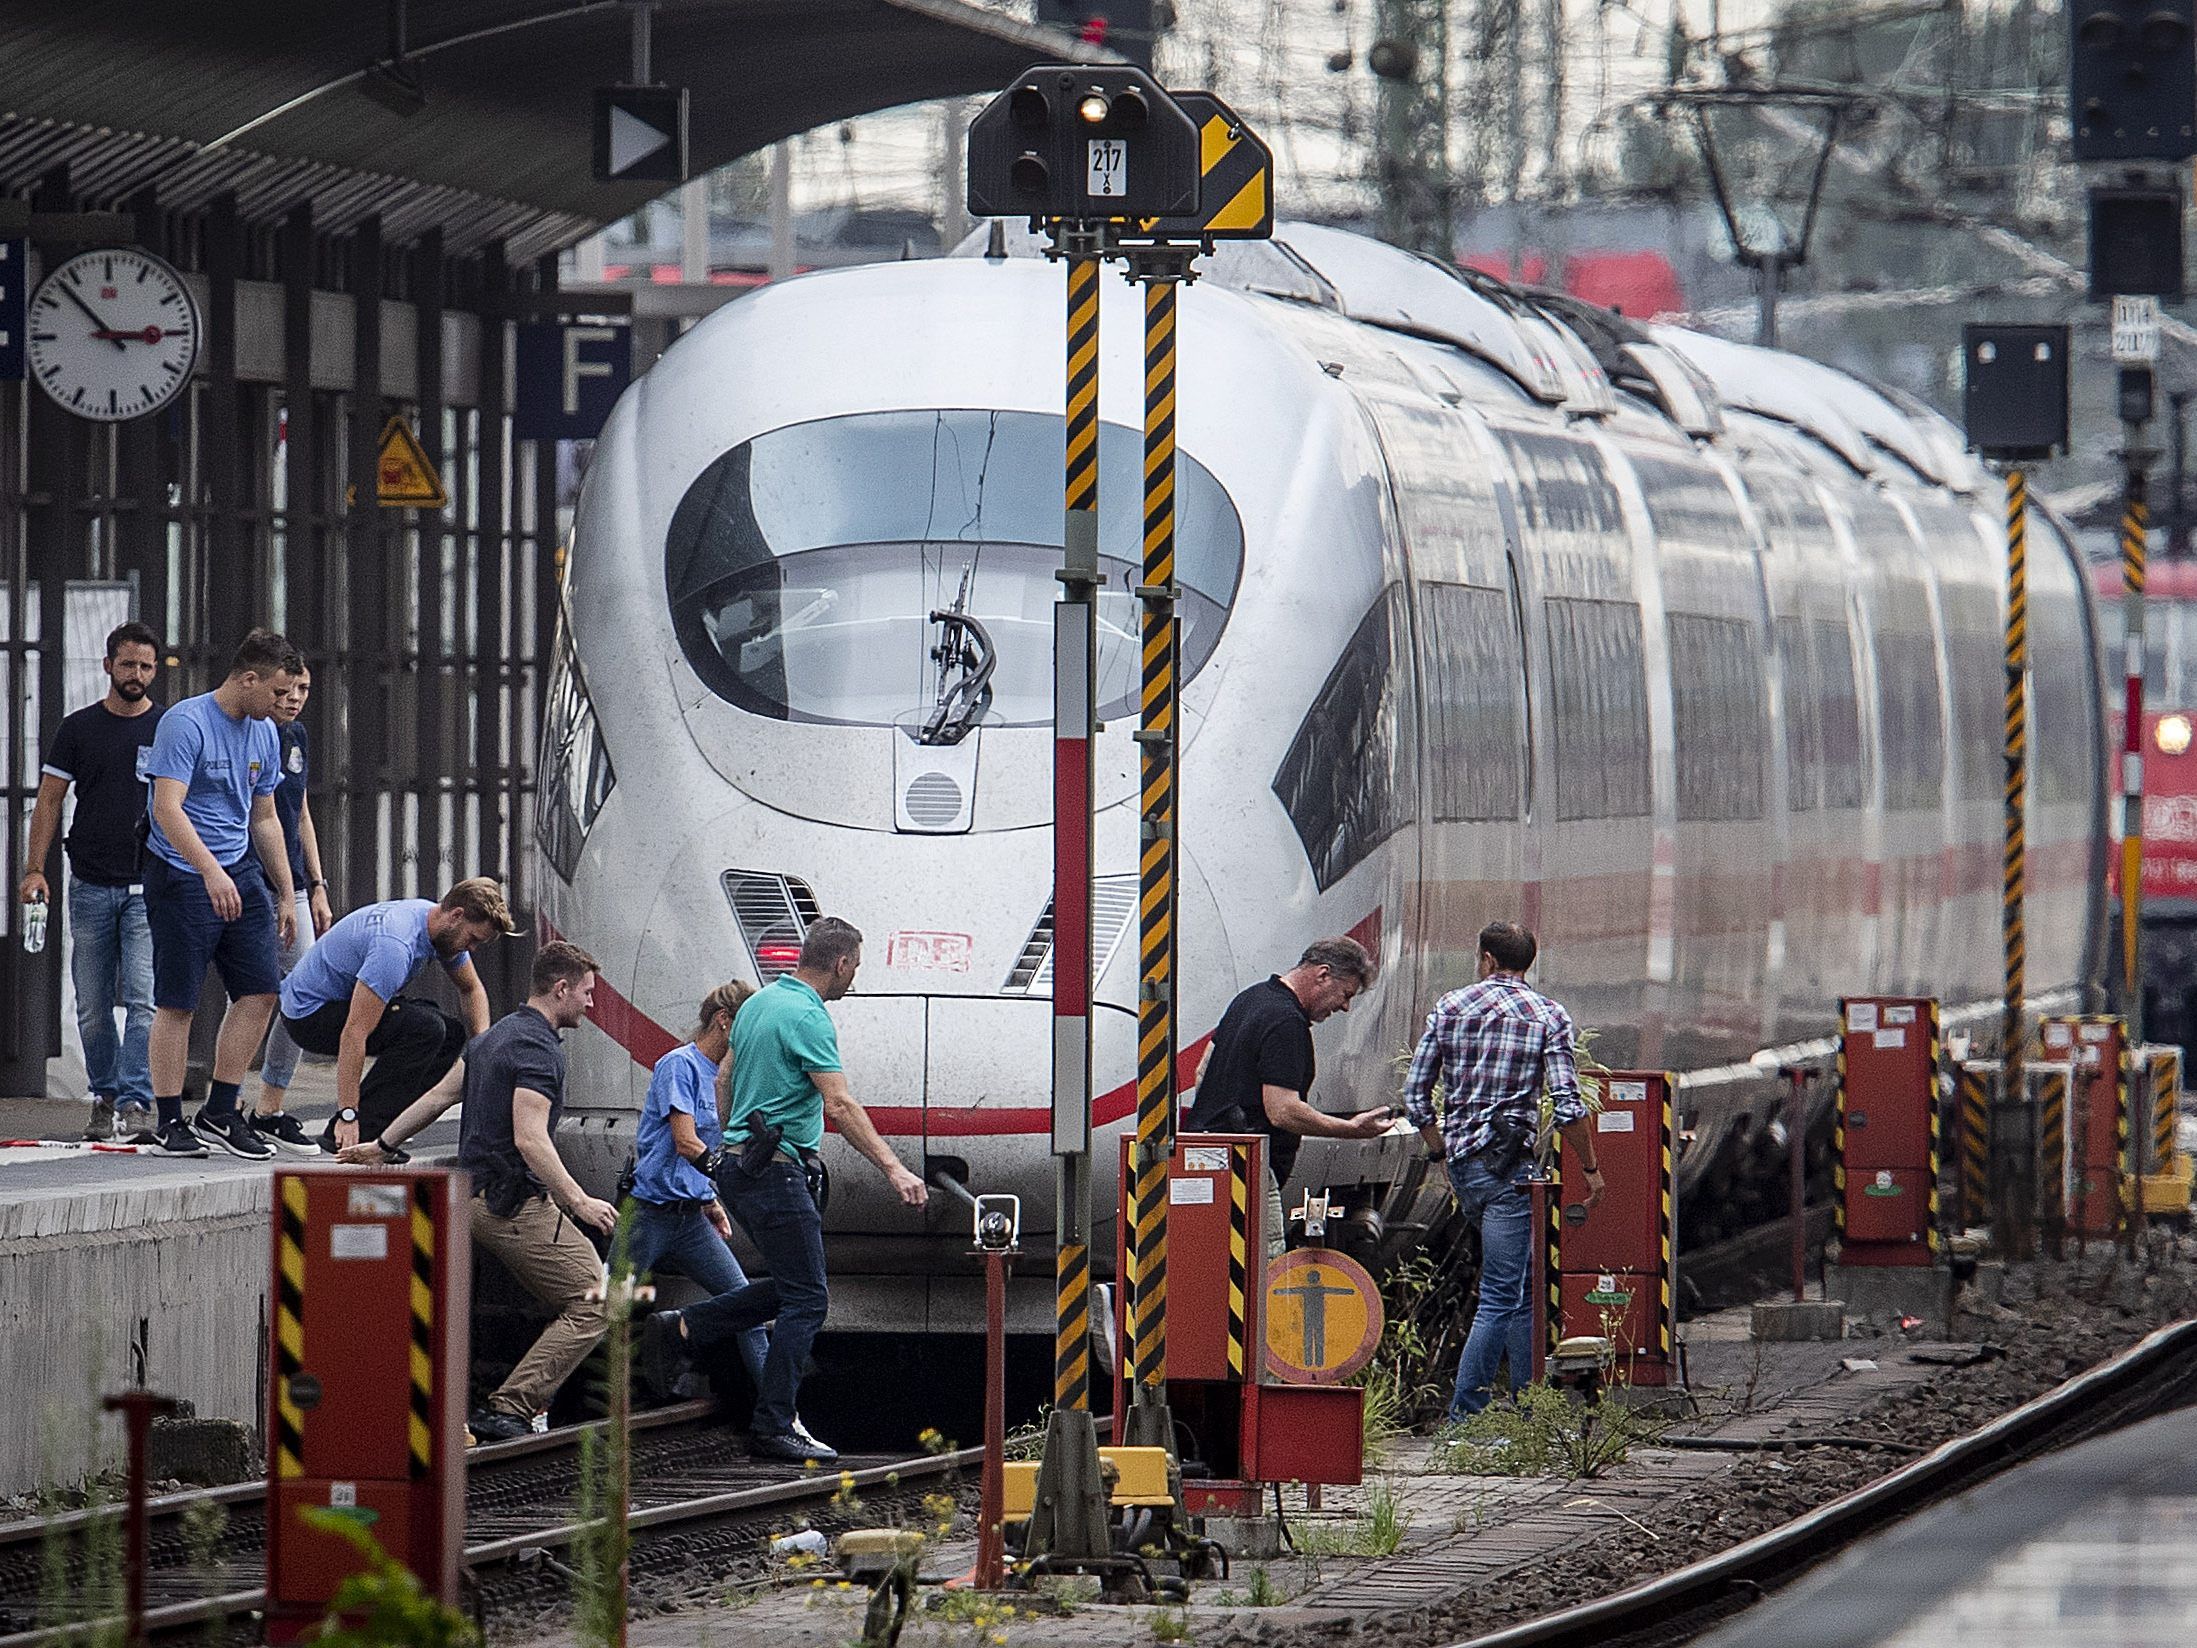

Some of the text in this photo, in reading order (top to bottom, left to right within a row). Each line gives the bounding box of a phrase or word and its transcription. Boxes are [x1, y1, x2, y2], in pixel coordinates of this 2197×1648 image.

[1093, 148, 1122, 172] 217
[563, 327, 615, 414] F
[890, 934, 969, 971] DB
